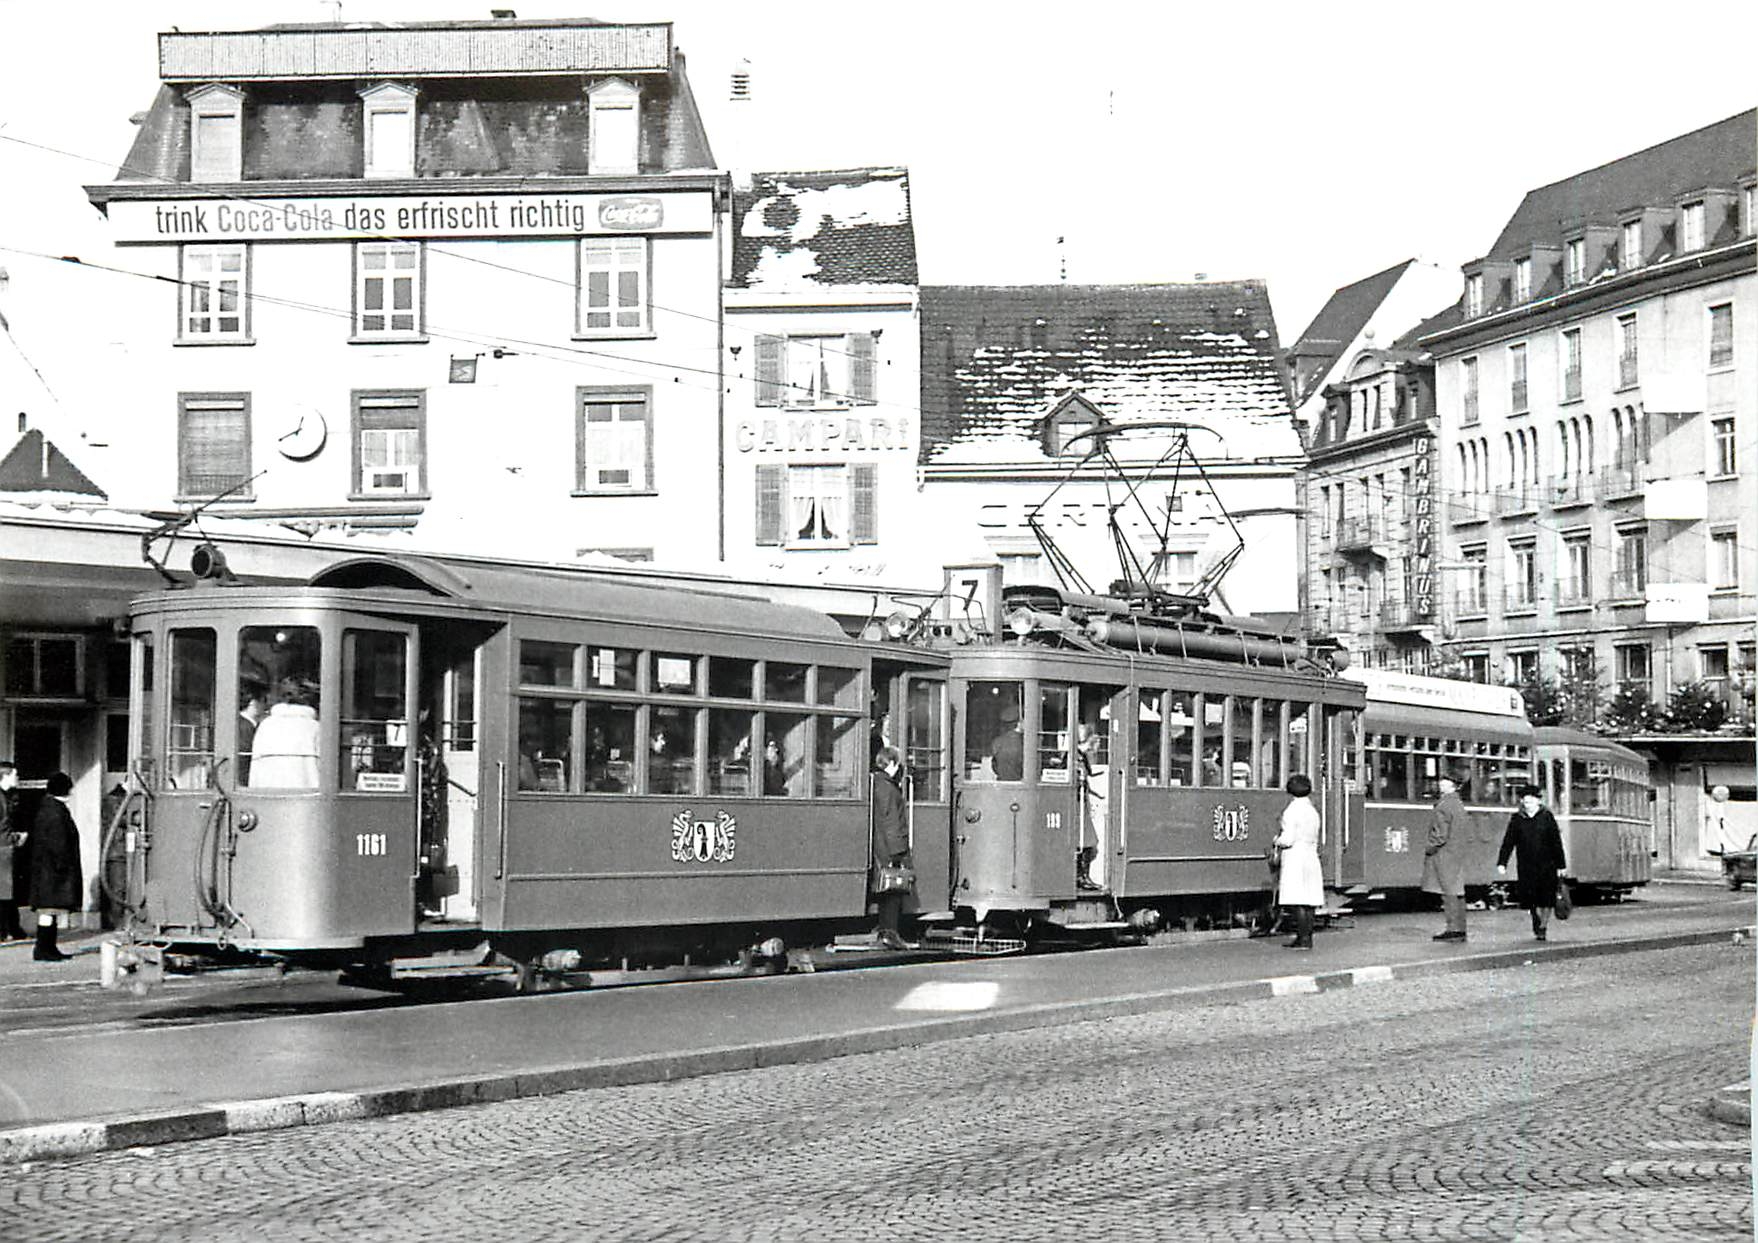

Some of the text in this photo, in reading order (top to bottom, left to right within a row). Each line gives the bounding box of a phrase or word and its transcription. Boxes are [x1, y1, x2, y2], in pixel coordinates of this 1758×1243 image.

[155, 199, 585, 234] trink Coca-Cola das erfrischt richtig
[736, 417, 909, 453] CAMPARI
[1415, 437, 1431, 615] GAMBRINUS
[961, 579, 978, 611] 7
[356, 833, 387, 856] 1161
